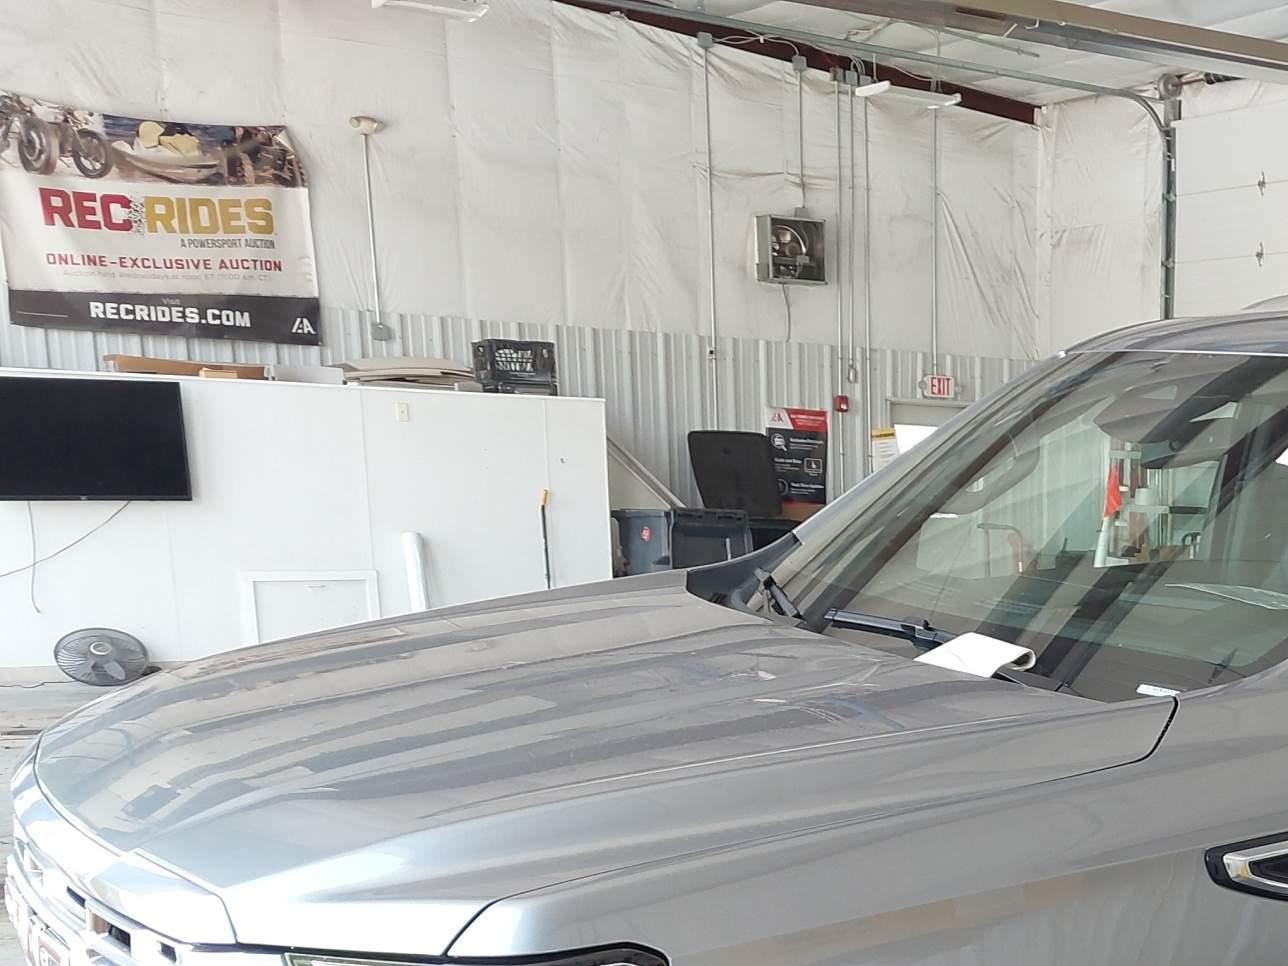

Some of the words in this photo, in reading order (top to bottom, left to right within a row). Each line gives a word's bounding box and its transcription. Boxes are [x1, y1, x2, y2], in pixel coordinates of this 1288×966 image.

[38, 187, 133, 232] REC
[143, 196, 274, 235] RIDES
[180, 239, 187, 248] A
[188, 239, 242, 249] POWERSPORT
[244, 239, 275, 250] AUCTION
[46, 252, 212, 270] ONLINE-EXCLUSIVE
[218, 258, 283, 272] AUCTION
[89, 301, 251, 328] RECRIDES.COM
[931, 376, 952, 396] EXIT
